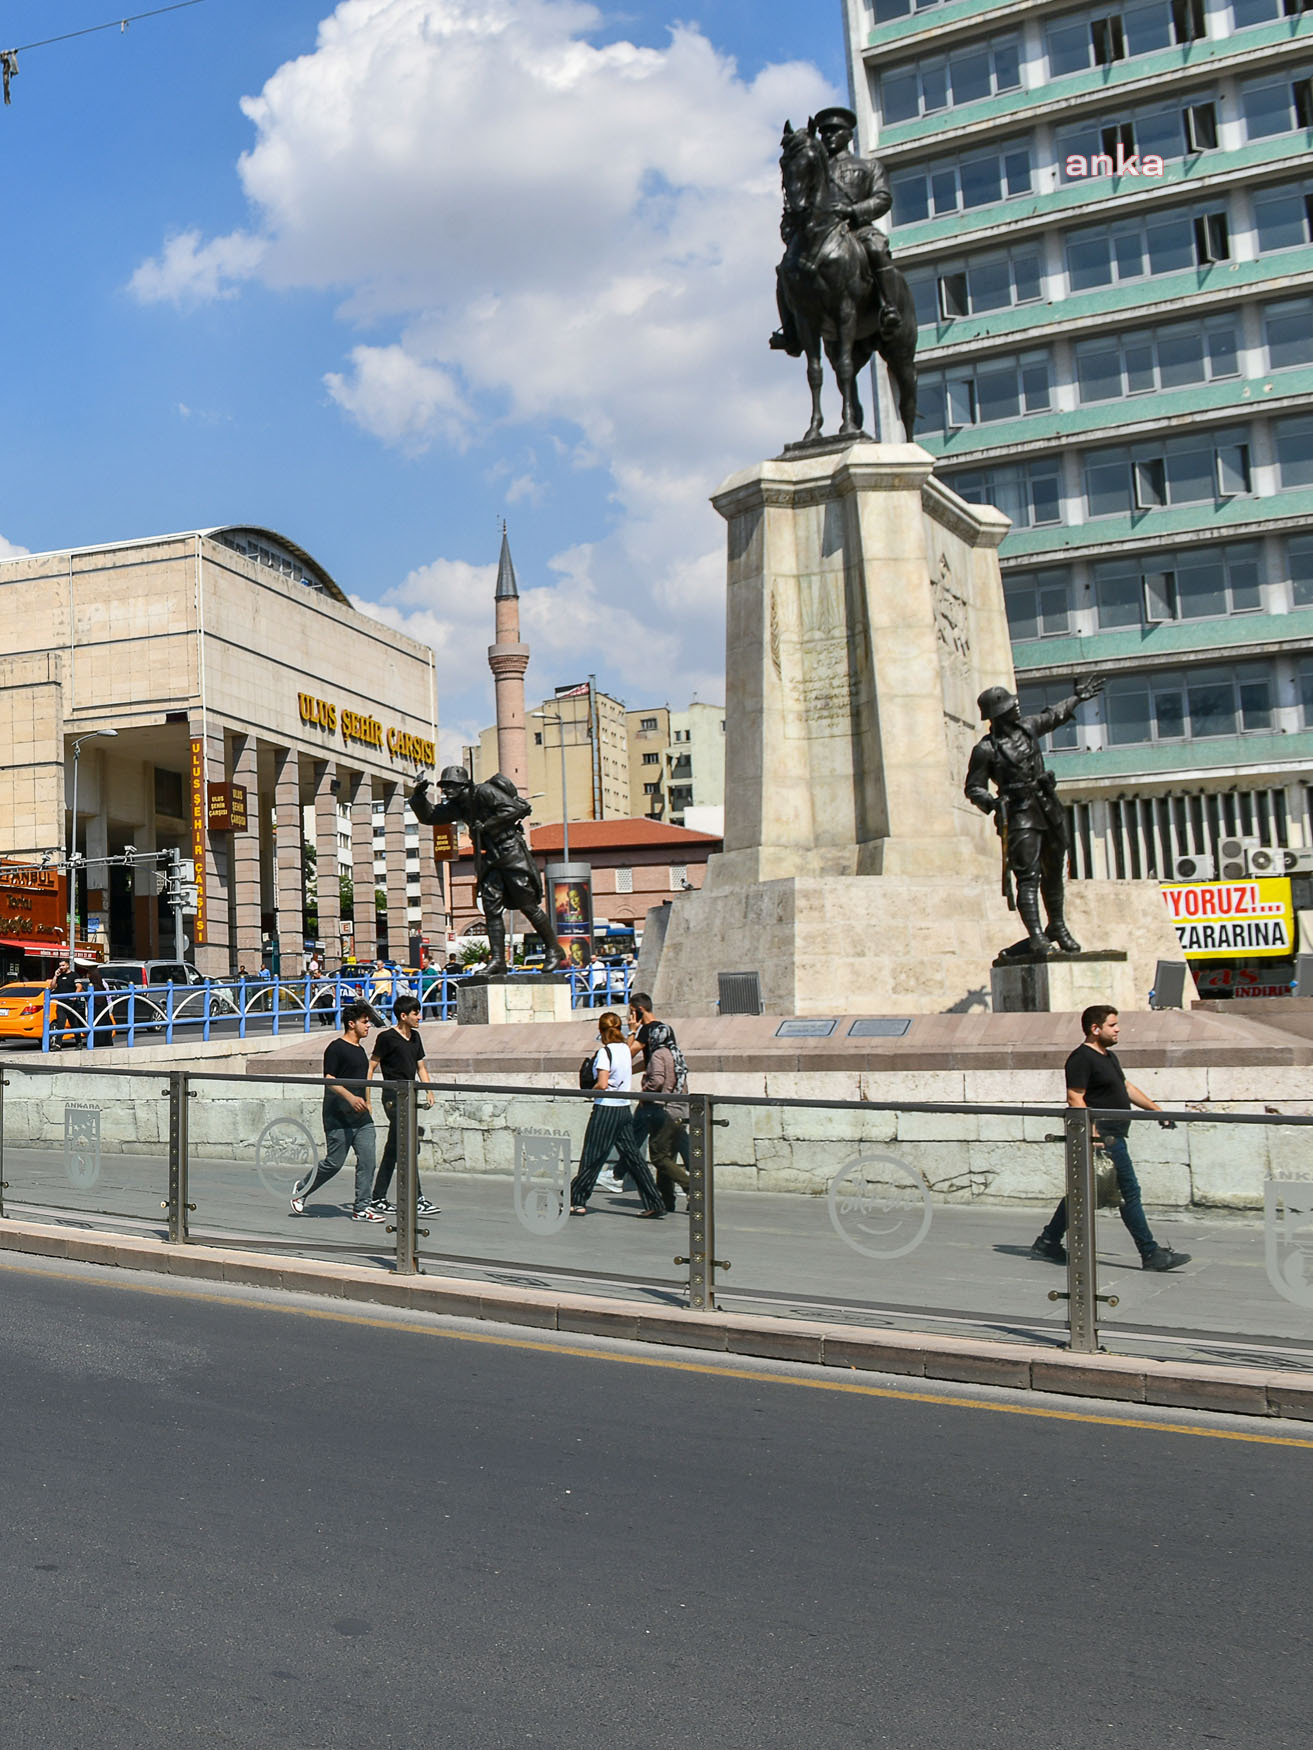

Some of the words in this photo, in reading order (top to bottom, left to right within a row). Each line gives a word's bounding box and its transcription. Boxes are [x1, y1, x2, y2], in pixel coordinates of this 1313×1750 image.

[297, 692, 338, 730] ULUS
[340, 709, 385, 747] ŞEHİR
[386, 727, 436, 767] ÇARŞISI
[192, 744, 201, 788] ULUS
[193, 793, 203, 855] ŞEHİR
[1175, 922, 1285, 949] ZARARINA
[64, 1102, 101, 1110] ANKARA
[515, 1127, 570, 1137] ANKARA
